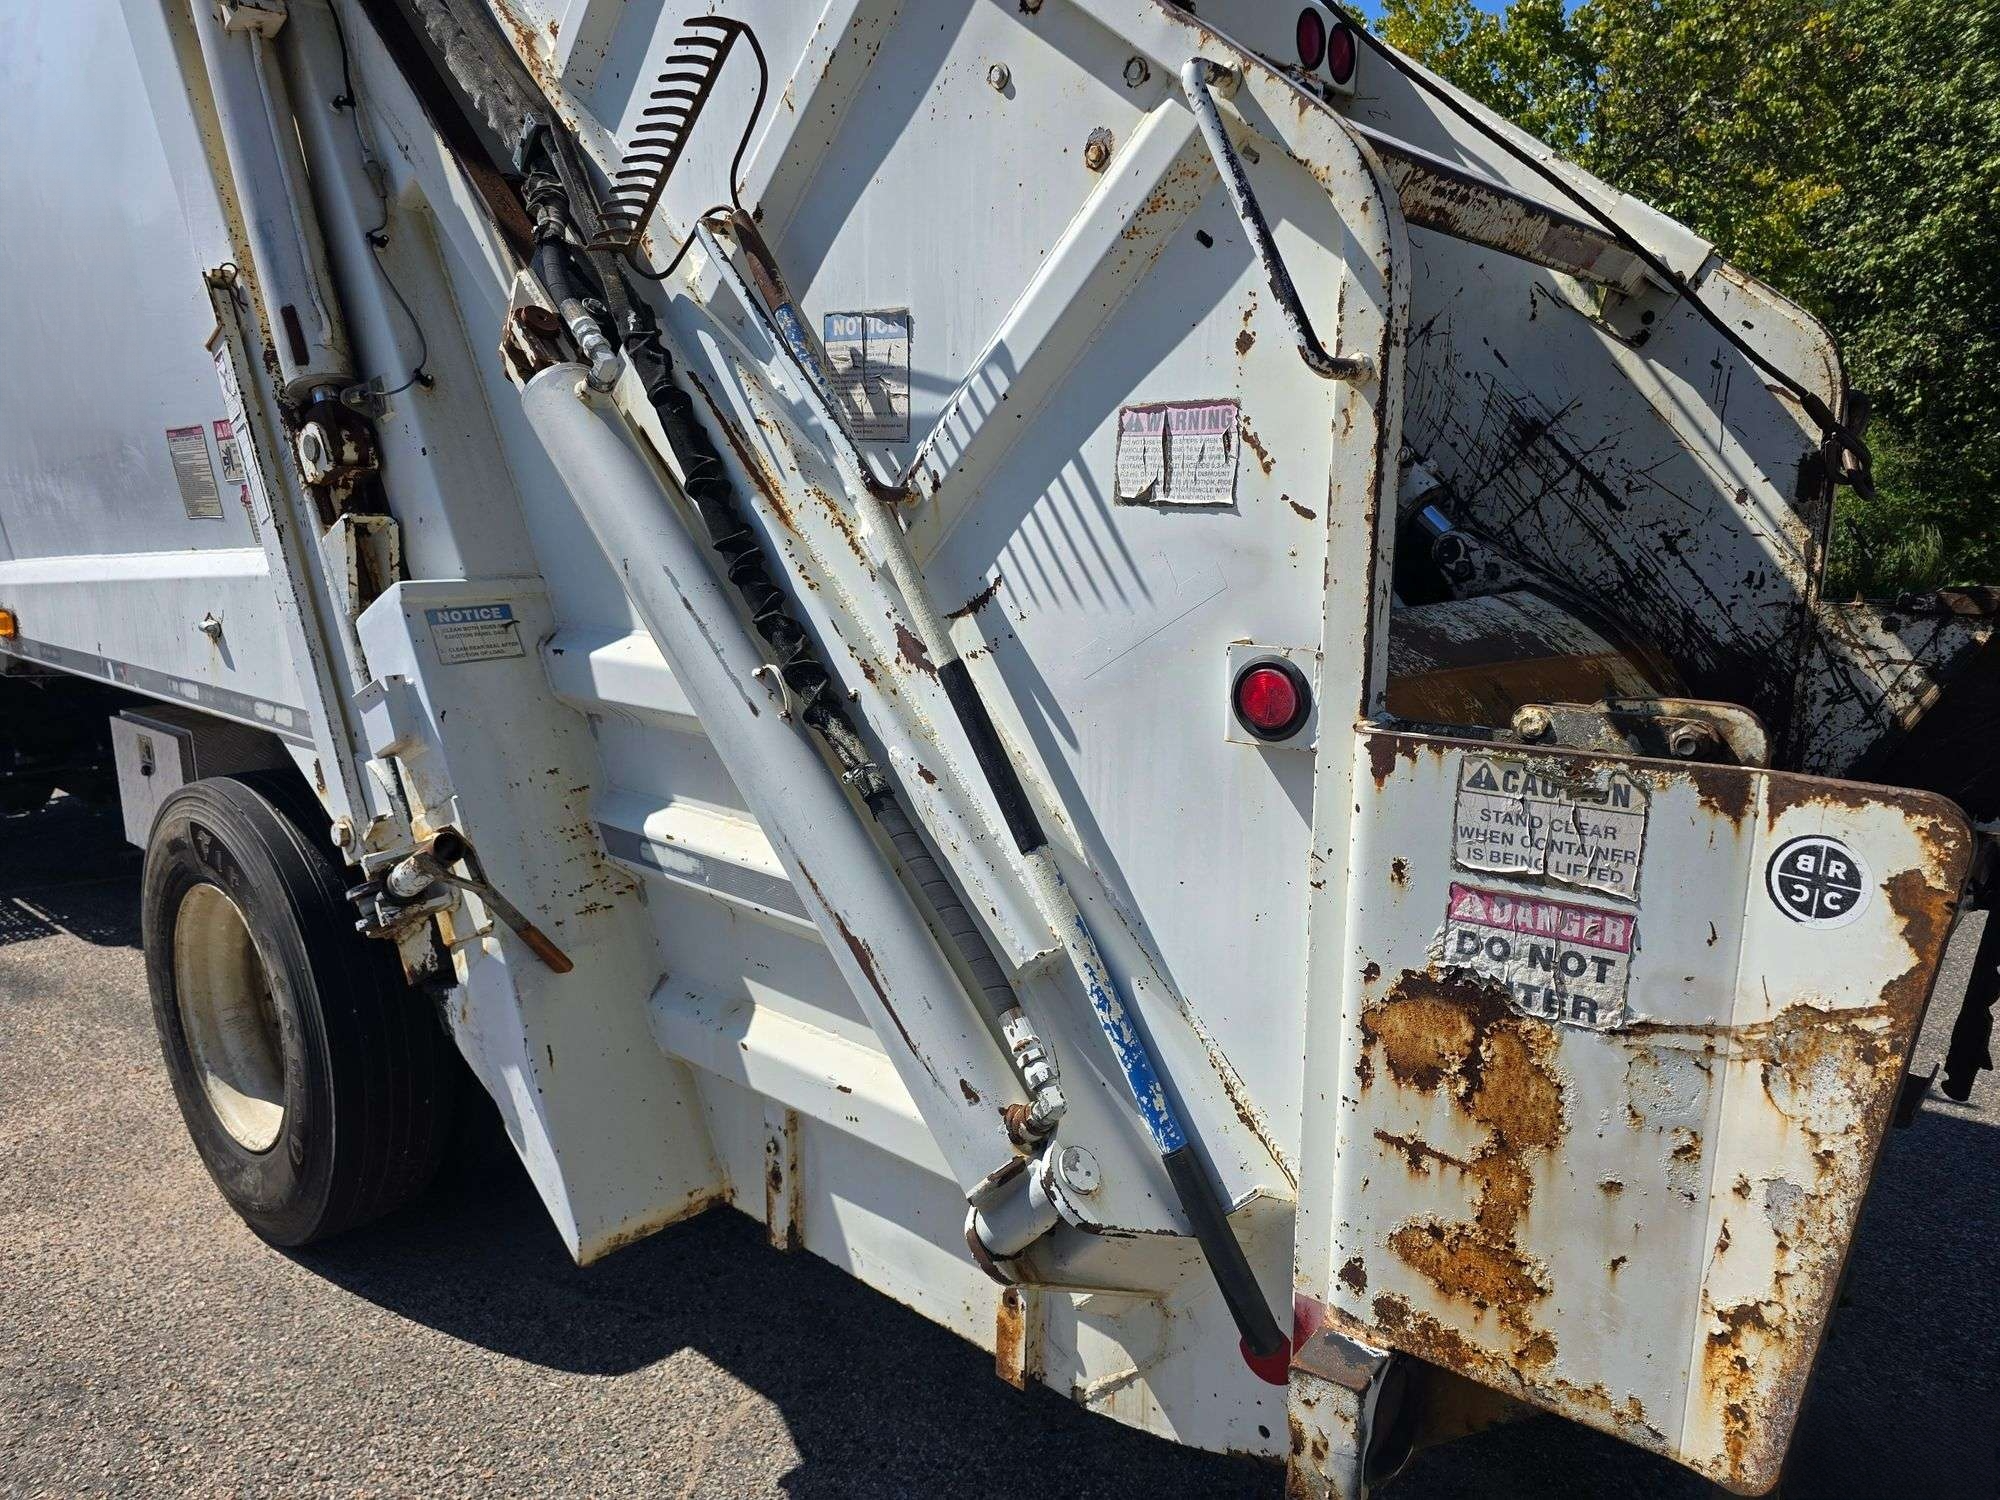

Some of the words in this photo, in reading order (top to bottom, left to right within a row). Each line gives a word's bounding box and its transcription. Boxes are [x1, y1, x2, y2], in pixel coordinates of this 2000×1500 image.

[833, 318, 898, 335] NOICE
[437, 607, 502, 622] NOTICE
[1501, 769, 1632, 809] CAUN
[1479, 807, 1544, 829] STAND
[1550, 818, 1617, 841] CLEAR
[1459, 824, 1514, 847] WHEN
[1520, 834, 1637, 865] CONTAINER
[1467, 847, 1485, 862] IS
[1488, 849, 1545, 871] BEING
[1554, 860, 1625, 884] LIFTED
[1491, 895, 1626, 946] DANGER
[1456, 928, 1511, 963] DO
[1528, 942, 1616, 984] NOT
